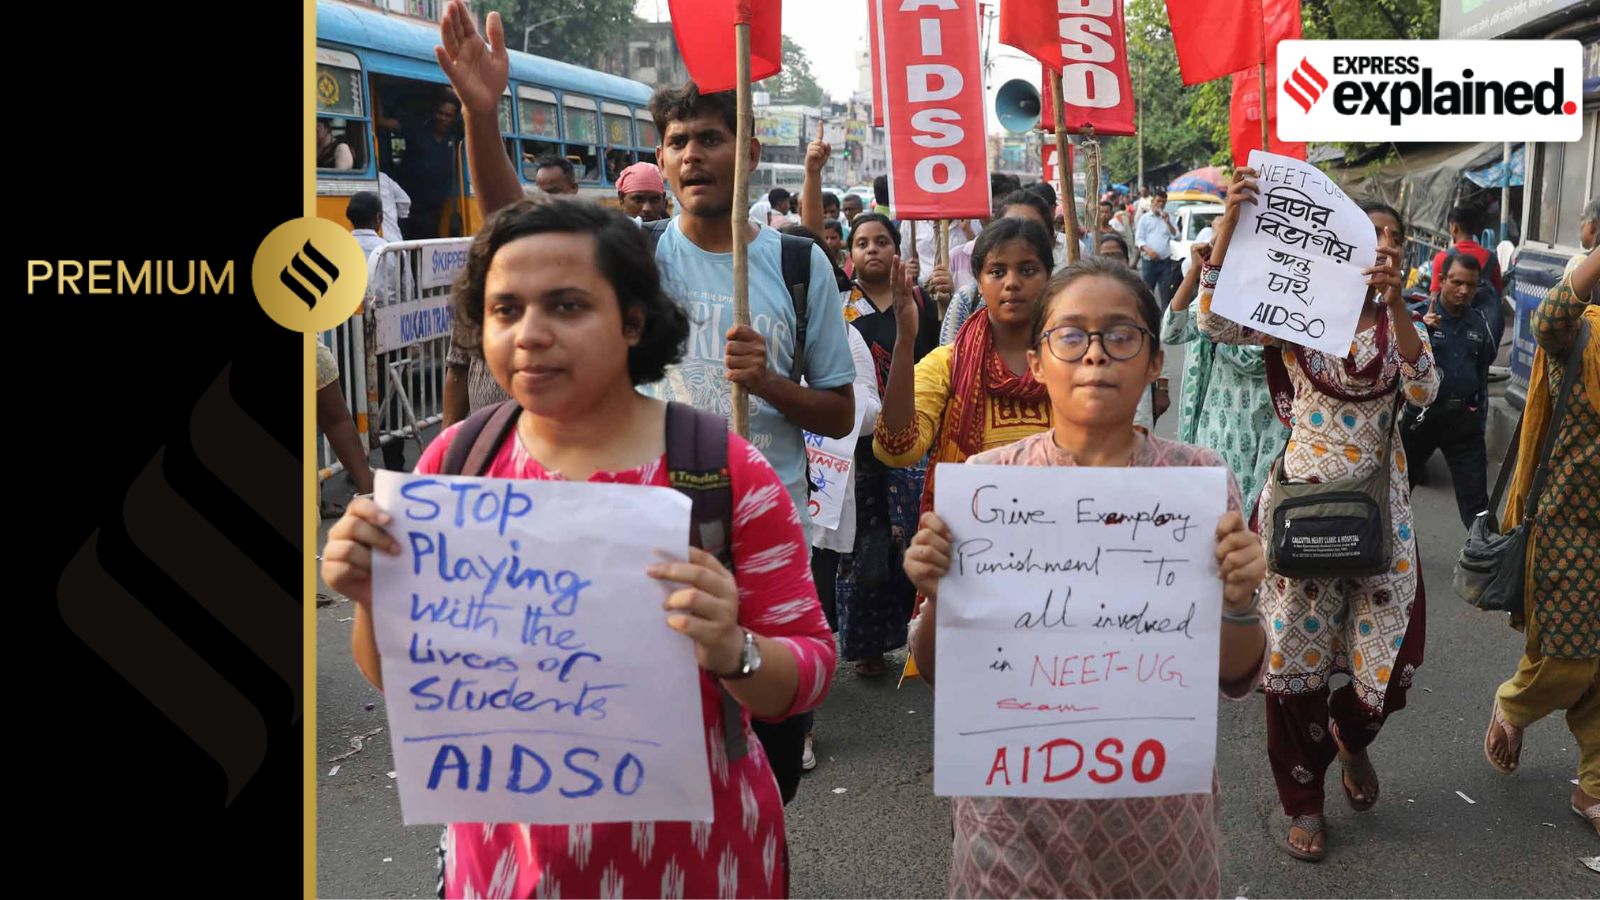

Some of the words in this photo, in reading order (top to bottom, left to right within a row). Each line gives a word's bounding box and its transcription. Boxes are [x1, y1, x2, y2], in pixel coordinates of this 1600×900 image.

[1264, 186, 1336, 229] বিচার
[1255, 211, 1358, 264] বিভাগীয়
[1267, 248, 1315, 276] তদন্ত
[400, 309, 431, 343] KOLKATA
[1250, 302, 1326, 338] AIDSO
[972, 485, 1056, 525] Give
[407, 531, 592, 616] Playing
[957, 538, 1152, 577] Punishment
[1143, 557, 1189, 586] To
[1015, 586, 1078, 629] all
[1092, 602, 1196, 639] involved
[409, 633, 518, 672] Lives
[537, 651, 601, 682] of
[989, 647, 1014, 670] in
[1030, 651, 1191, 687] NEET-UG
[409, 677, 626, 720] Students
[426, 744, 645, 798] AIDSO
[985, 737, 1166, 786] AIDSO
